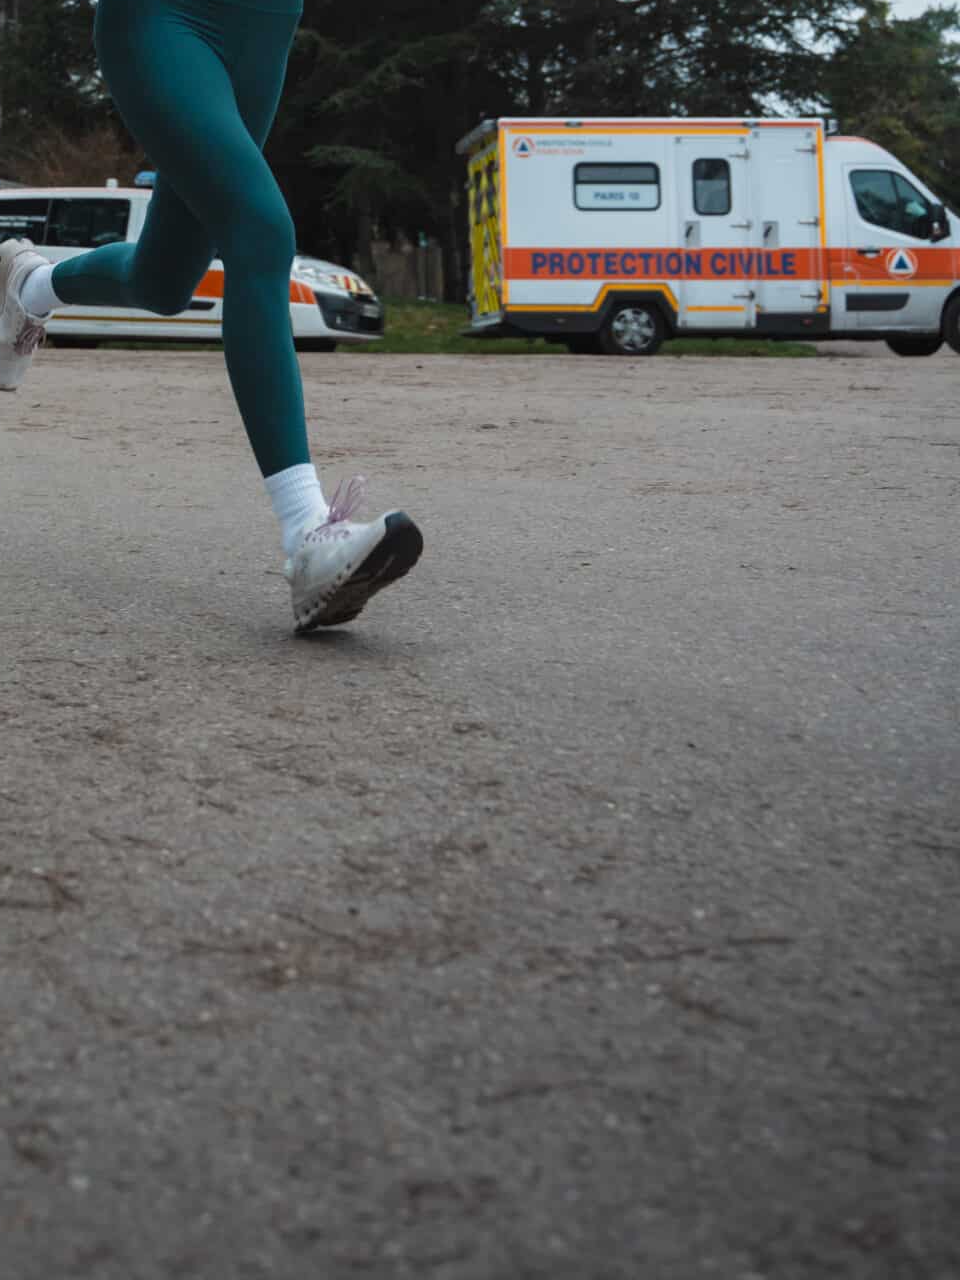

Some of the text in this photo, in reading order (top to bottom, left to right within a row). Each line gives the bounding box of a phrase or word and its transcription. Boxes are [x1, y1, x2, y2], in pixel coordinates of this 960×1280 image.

[593, 191, 624, 201] PARIS
[530, 252, 797, 276] PROTECTION CIVILE
